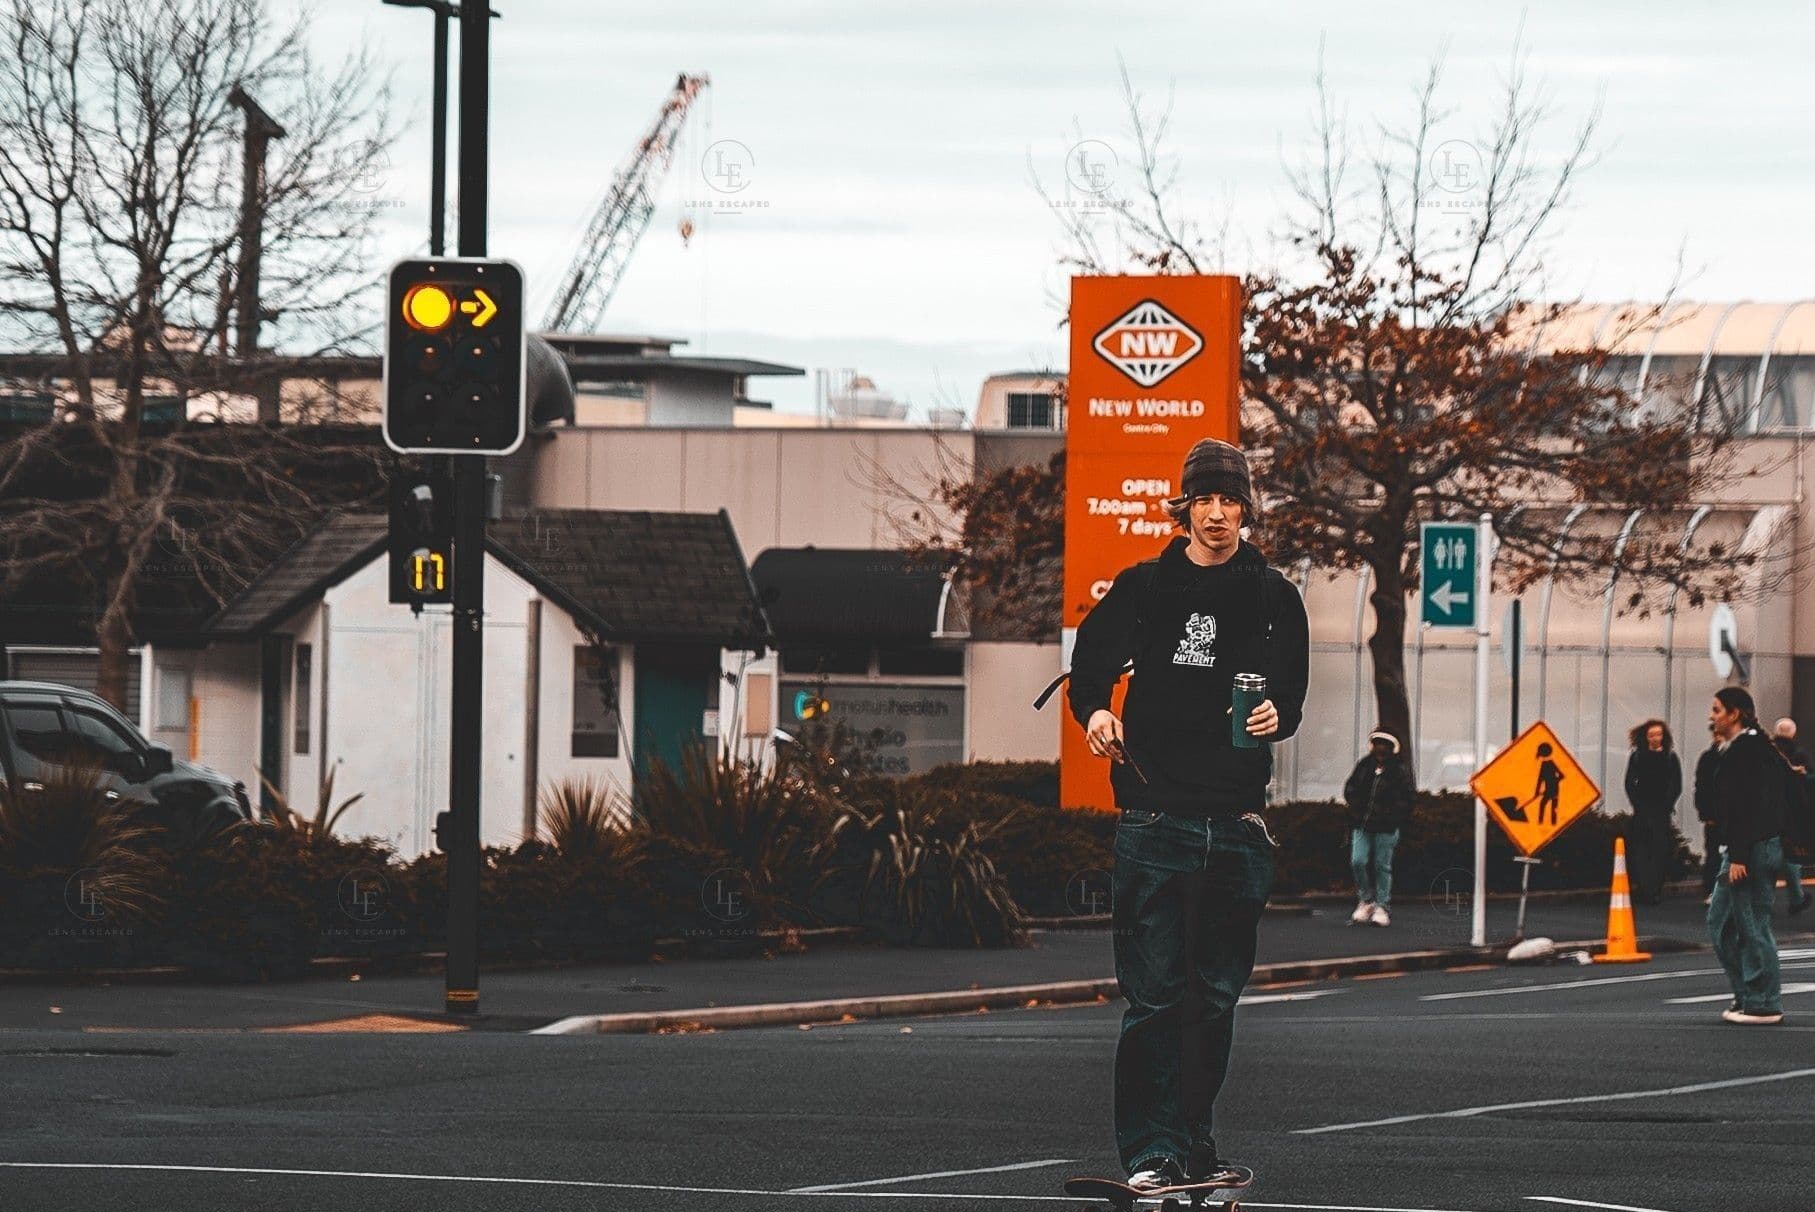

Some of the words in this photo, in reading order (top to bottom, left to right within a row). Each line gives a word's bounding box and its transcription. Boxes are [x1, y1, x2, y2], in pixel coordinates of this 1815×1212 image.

[1120, 331, 1178, 356] NW
[1088, 398, 1133, 417] NEW
[1136, 398, 1205, 417] WORLD
[1122, 479, 1171, 496] OPEN
[1118, 518, 1129, 535] 7
[1131, 517, 1173, 538] days
[415, 554, 444, 590] 17
[1173, 653, 1216, 665] PAVEMENT
